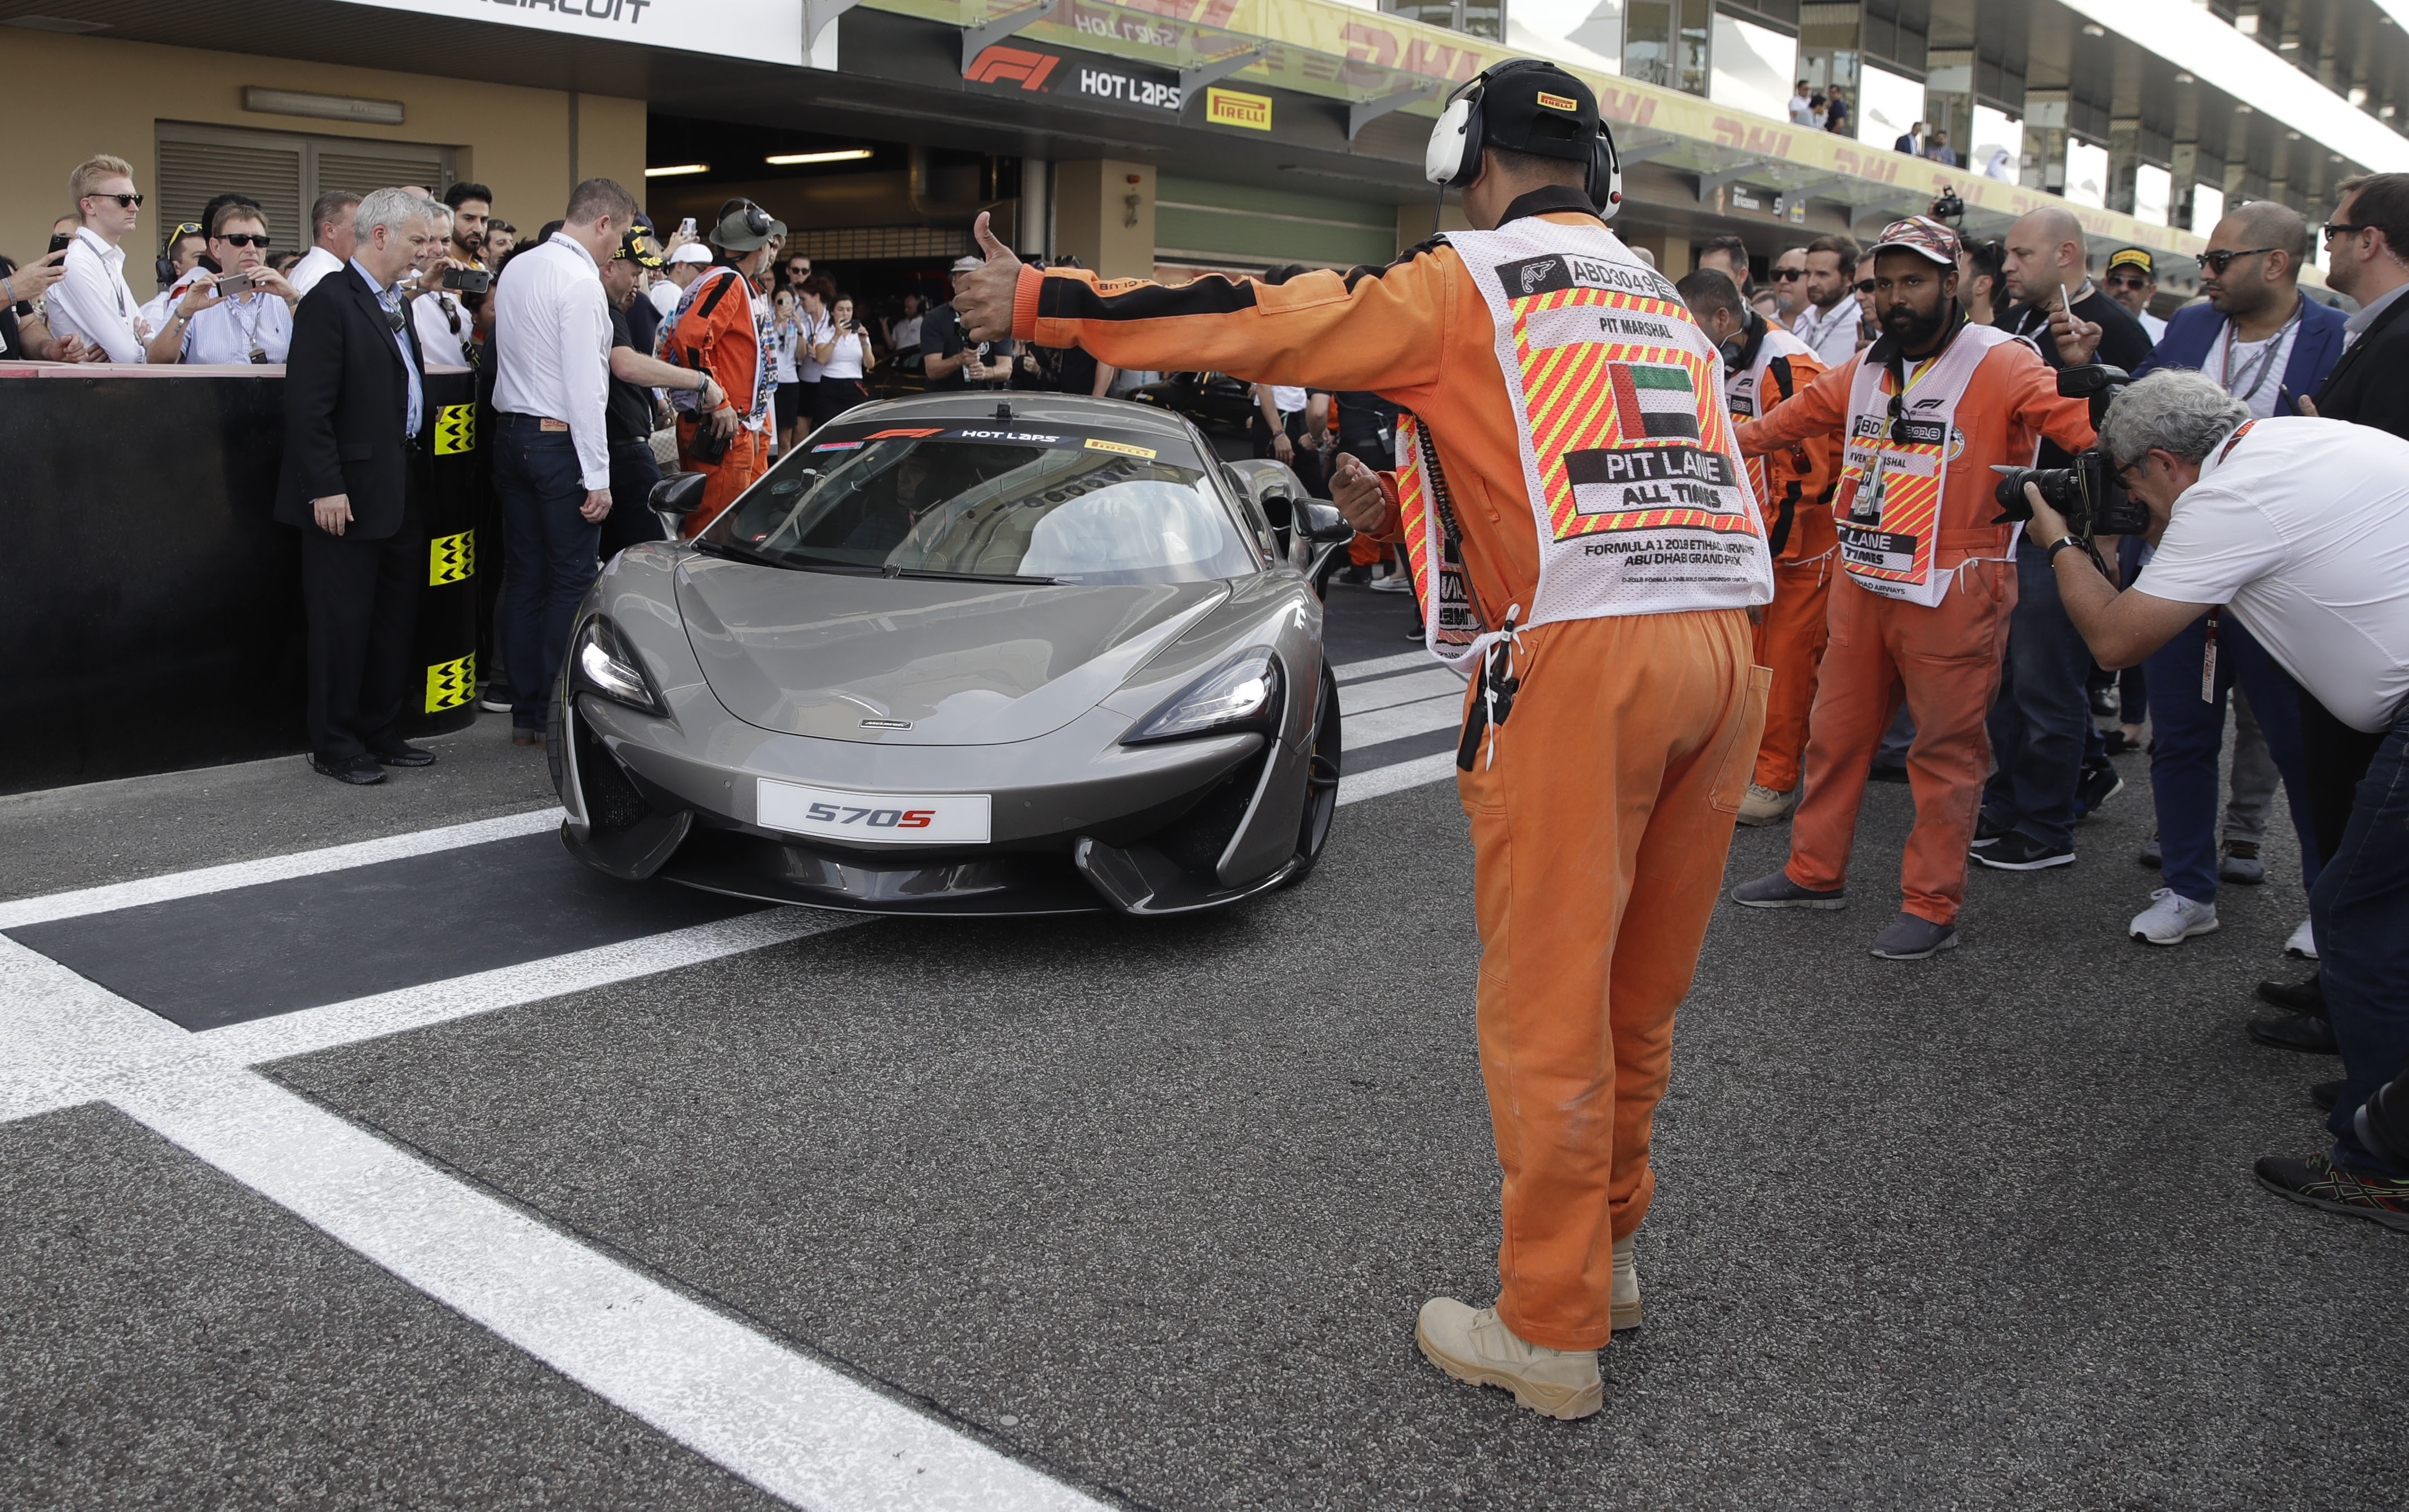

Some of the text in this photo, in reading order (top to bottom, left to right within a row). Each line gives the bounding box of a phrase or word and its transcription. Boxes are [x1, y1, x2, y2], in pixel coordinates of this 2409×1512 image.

[1335, 22, 1483, 99] DHL
[1081, 69, 1126, 99] HOT
[1214, 96, 1266, 123] PIRELLI
[1541, 95, 1573, 109] PIRELLI
[1712, 116, 1792, 159] DHL
[1573, 260, 1655, 292] ABD3049
[1599, 317, 1674, 338] PIT MARSHAL
[1091, 441, 1150, 456] PIRELLI
[1607, 452, 1721, 482] PIT LANE
[1623, 485, 1671, 507] ALL
[1585, 540, 1657, 556] FORMULA
[1657, 540, 1664, 550] 1
[1665, 539, 1688, 550] 2018
[1689, 539, 1723, 552] ETIHAD
[1847, 530, 1891, 550] LANE
[1625, 553, 1653, 568] ABU
[1654, 552, 1688, 564] DHABI
[1689, 552, 1724, 565] GRAND
[1845, 547, 1884, 565] TIMES
[1874, 585, 1906, 595] AIRWAYS
[805, 802, 936, 828] 570S
